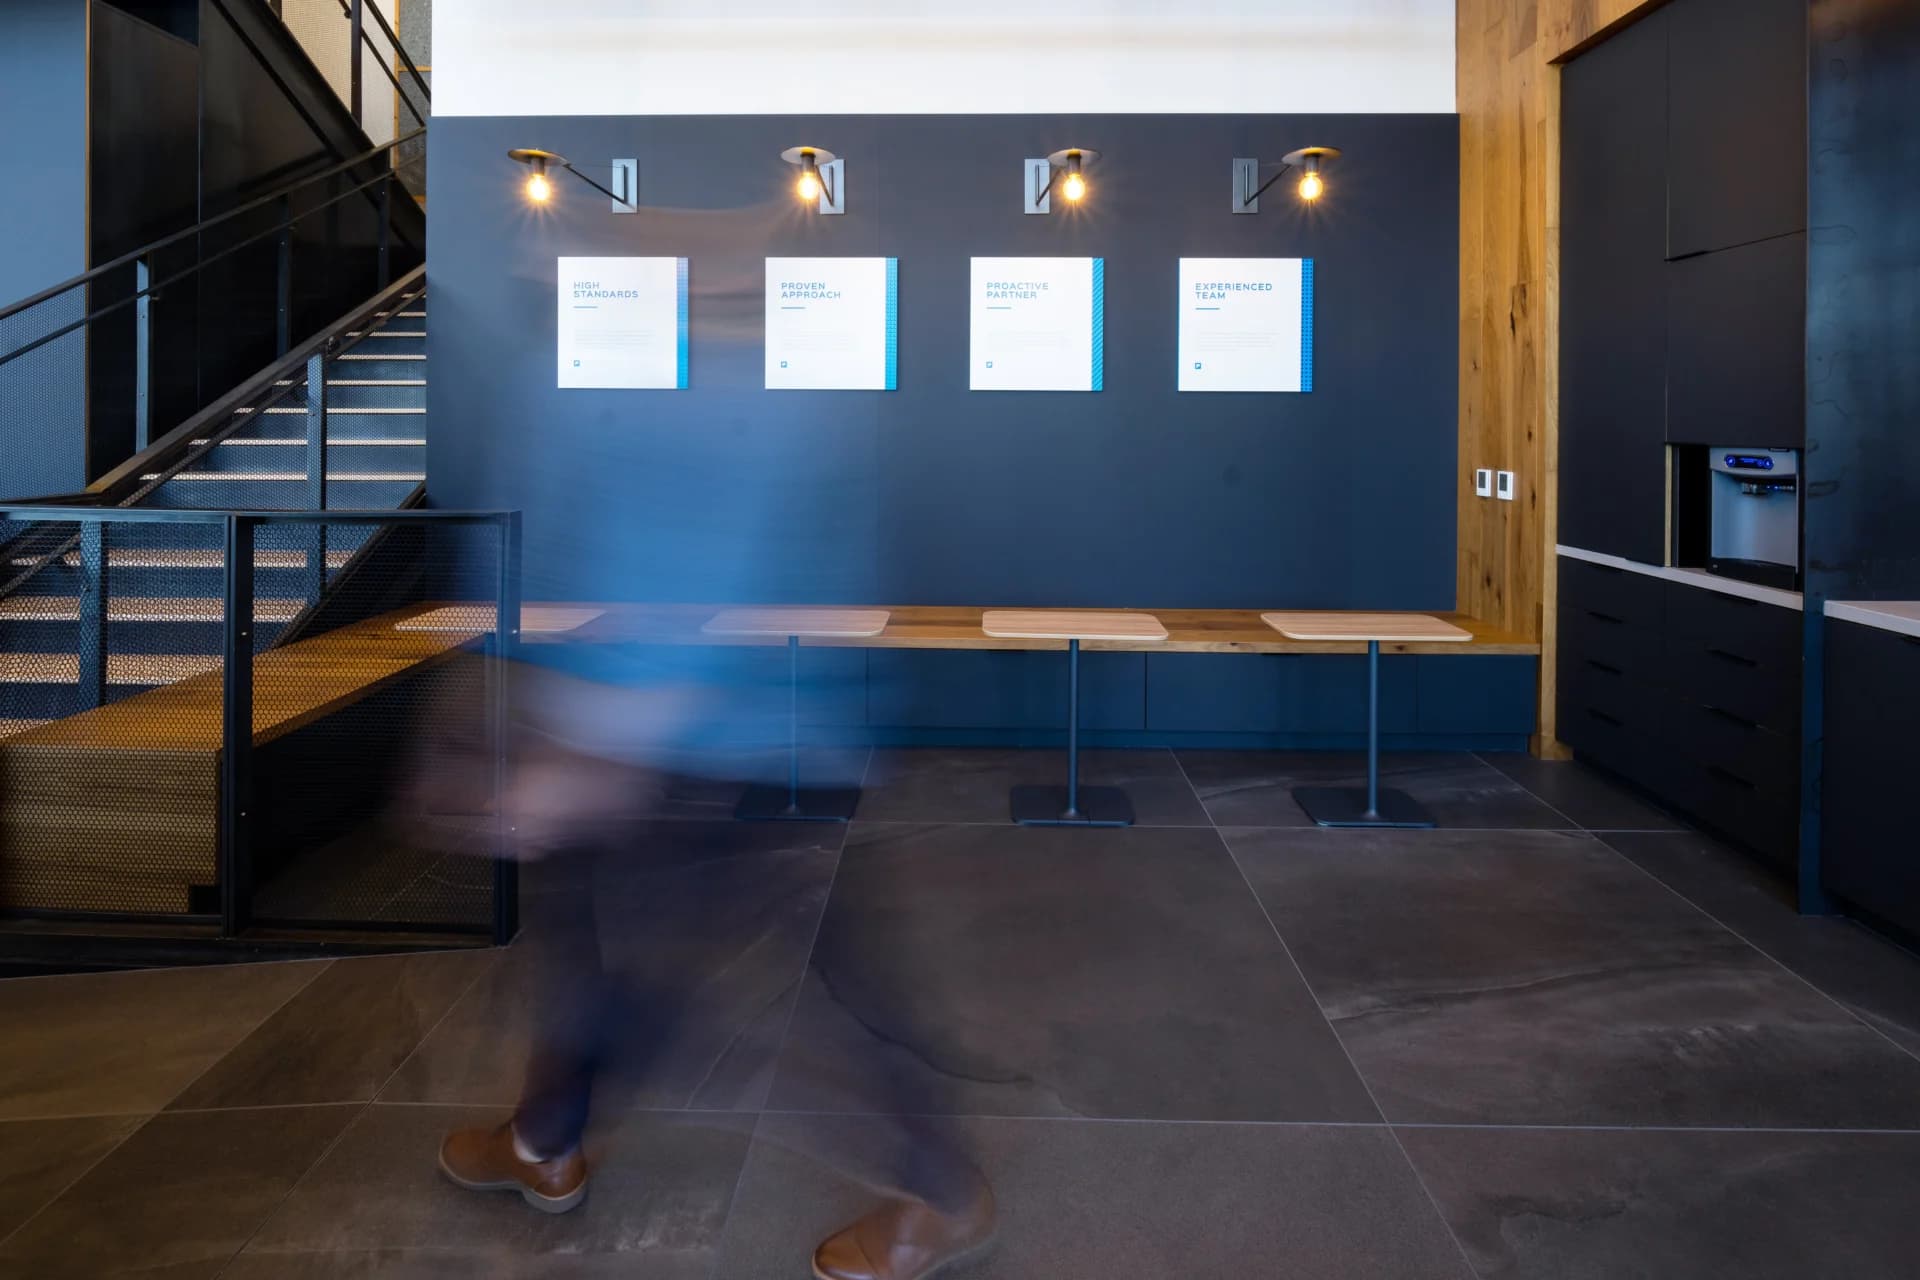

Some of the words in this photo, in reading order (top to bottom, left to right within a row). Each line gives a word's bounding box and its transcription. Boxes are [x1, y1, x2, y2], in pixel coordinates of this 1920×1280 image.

[573, 281, 600, 290] HIGH
[781, 282, 826, 290] PROVEN
[986, 282, 1049, 290] PROACTIVE
[1195, 283, 1273, 291] EXPERIENCED
[573, 290, 639, 298] STANDARDS
[781, 291, 841, 299] APPROACH
[986, 291, 1037, 299] PARTNER
[1195, 291, 1226, 299] TEAM
